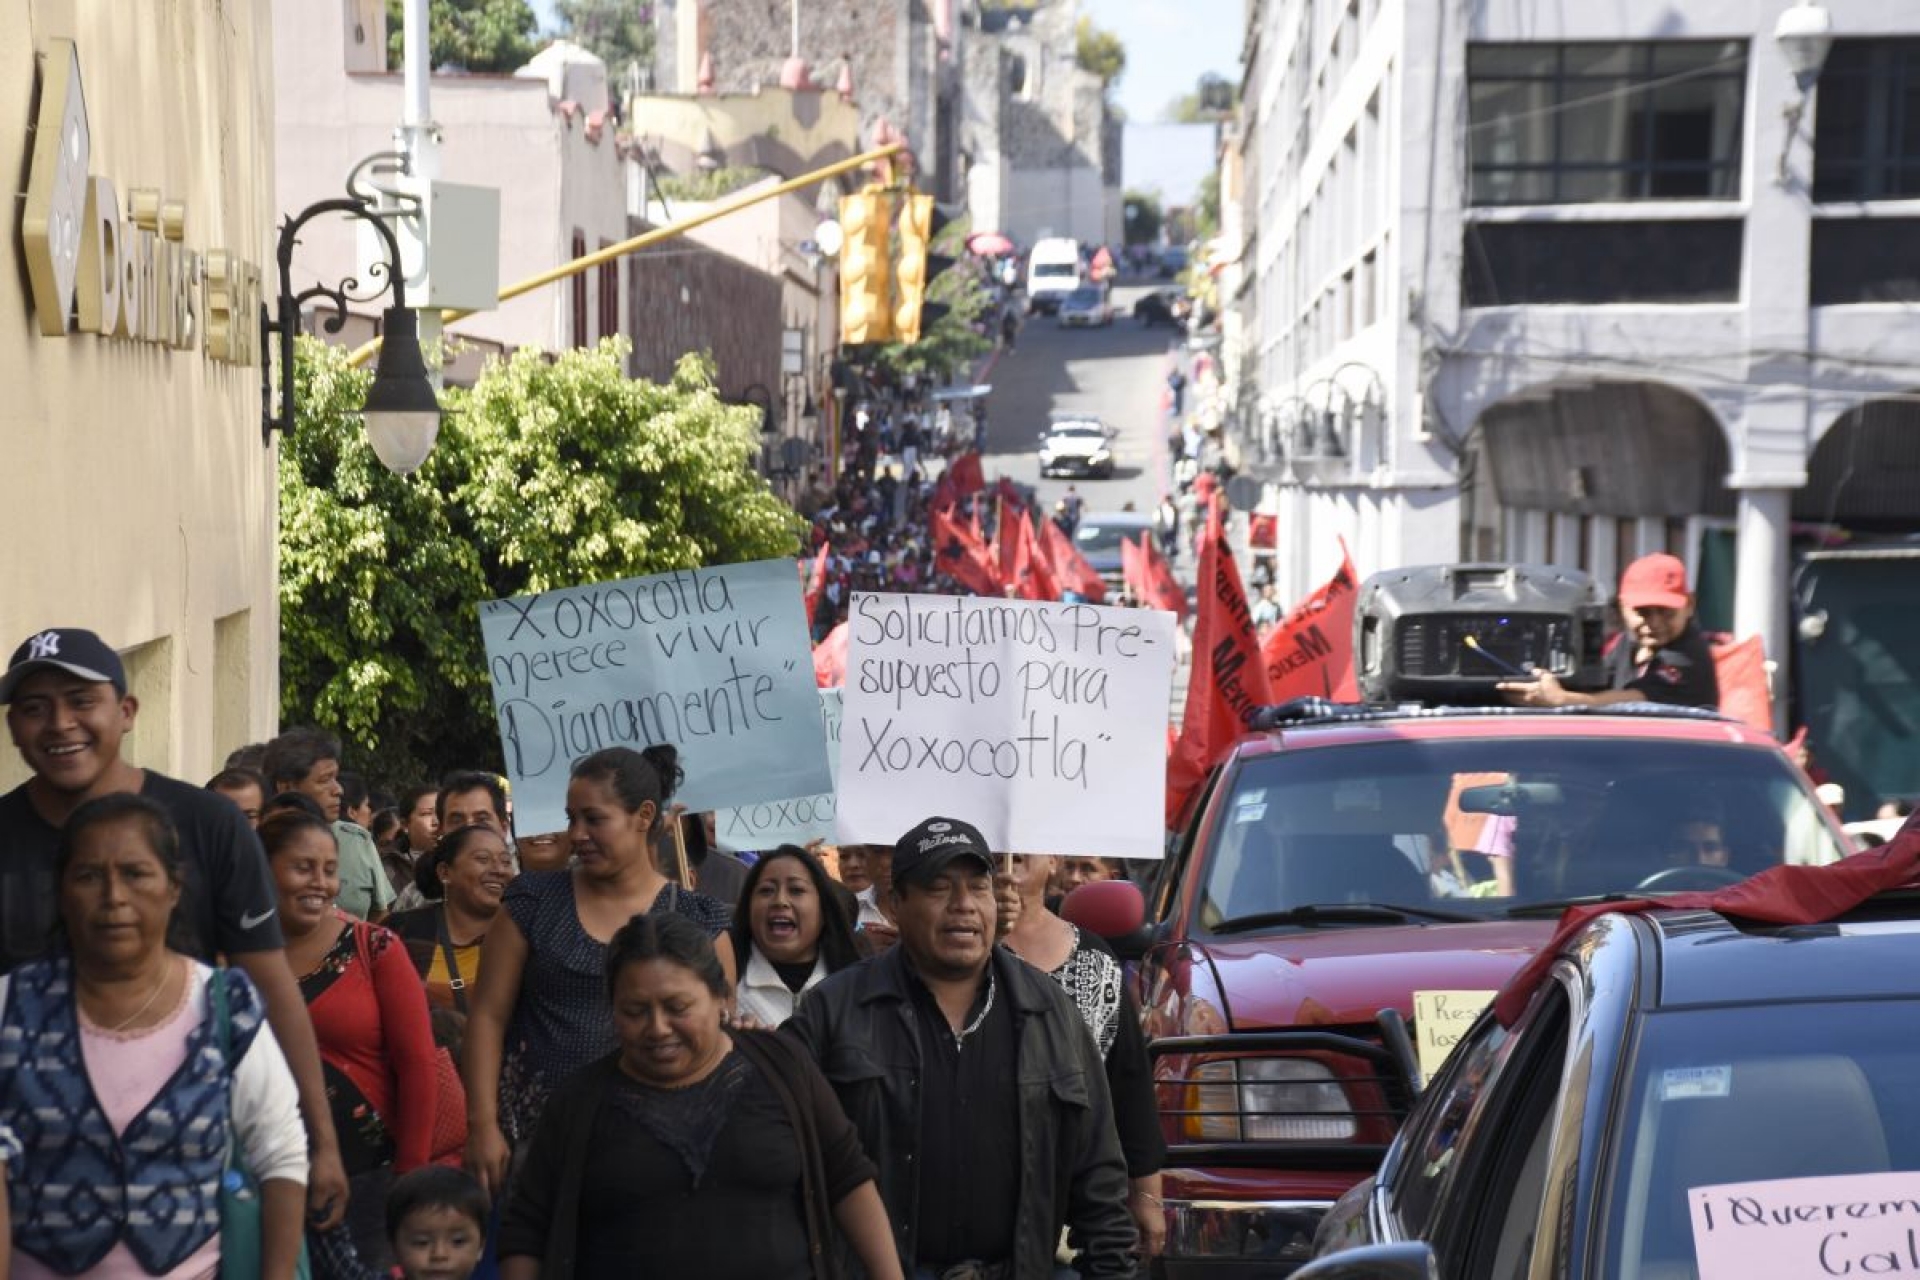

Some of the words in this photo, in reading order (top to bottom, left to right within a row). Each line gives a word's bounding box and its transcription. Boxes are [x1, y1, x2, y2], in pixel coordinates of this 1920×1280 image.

[491, 639, 627, 698] merece
[655, 615, 771, 659] vivir
[1060, 605, 1155, 657] Pre-
[859, 647, 1001, 711] supuesto
[1016, 659, 1109, 720] para
